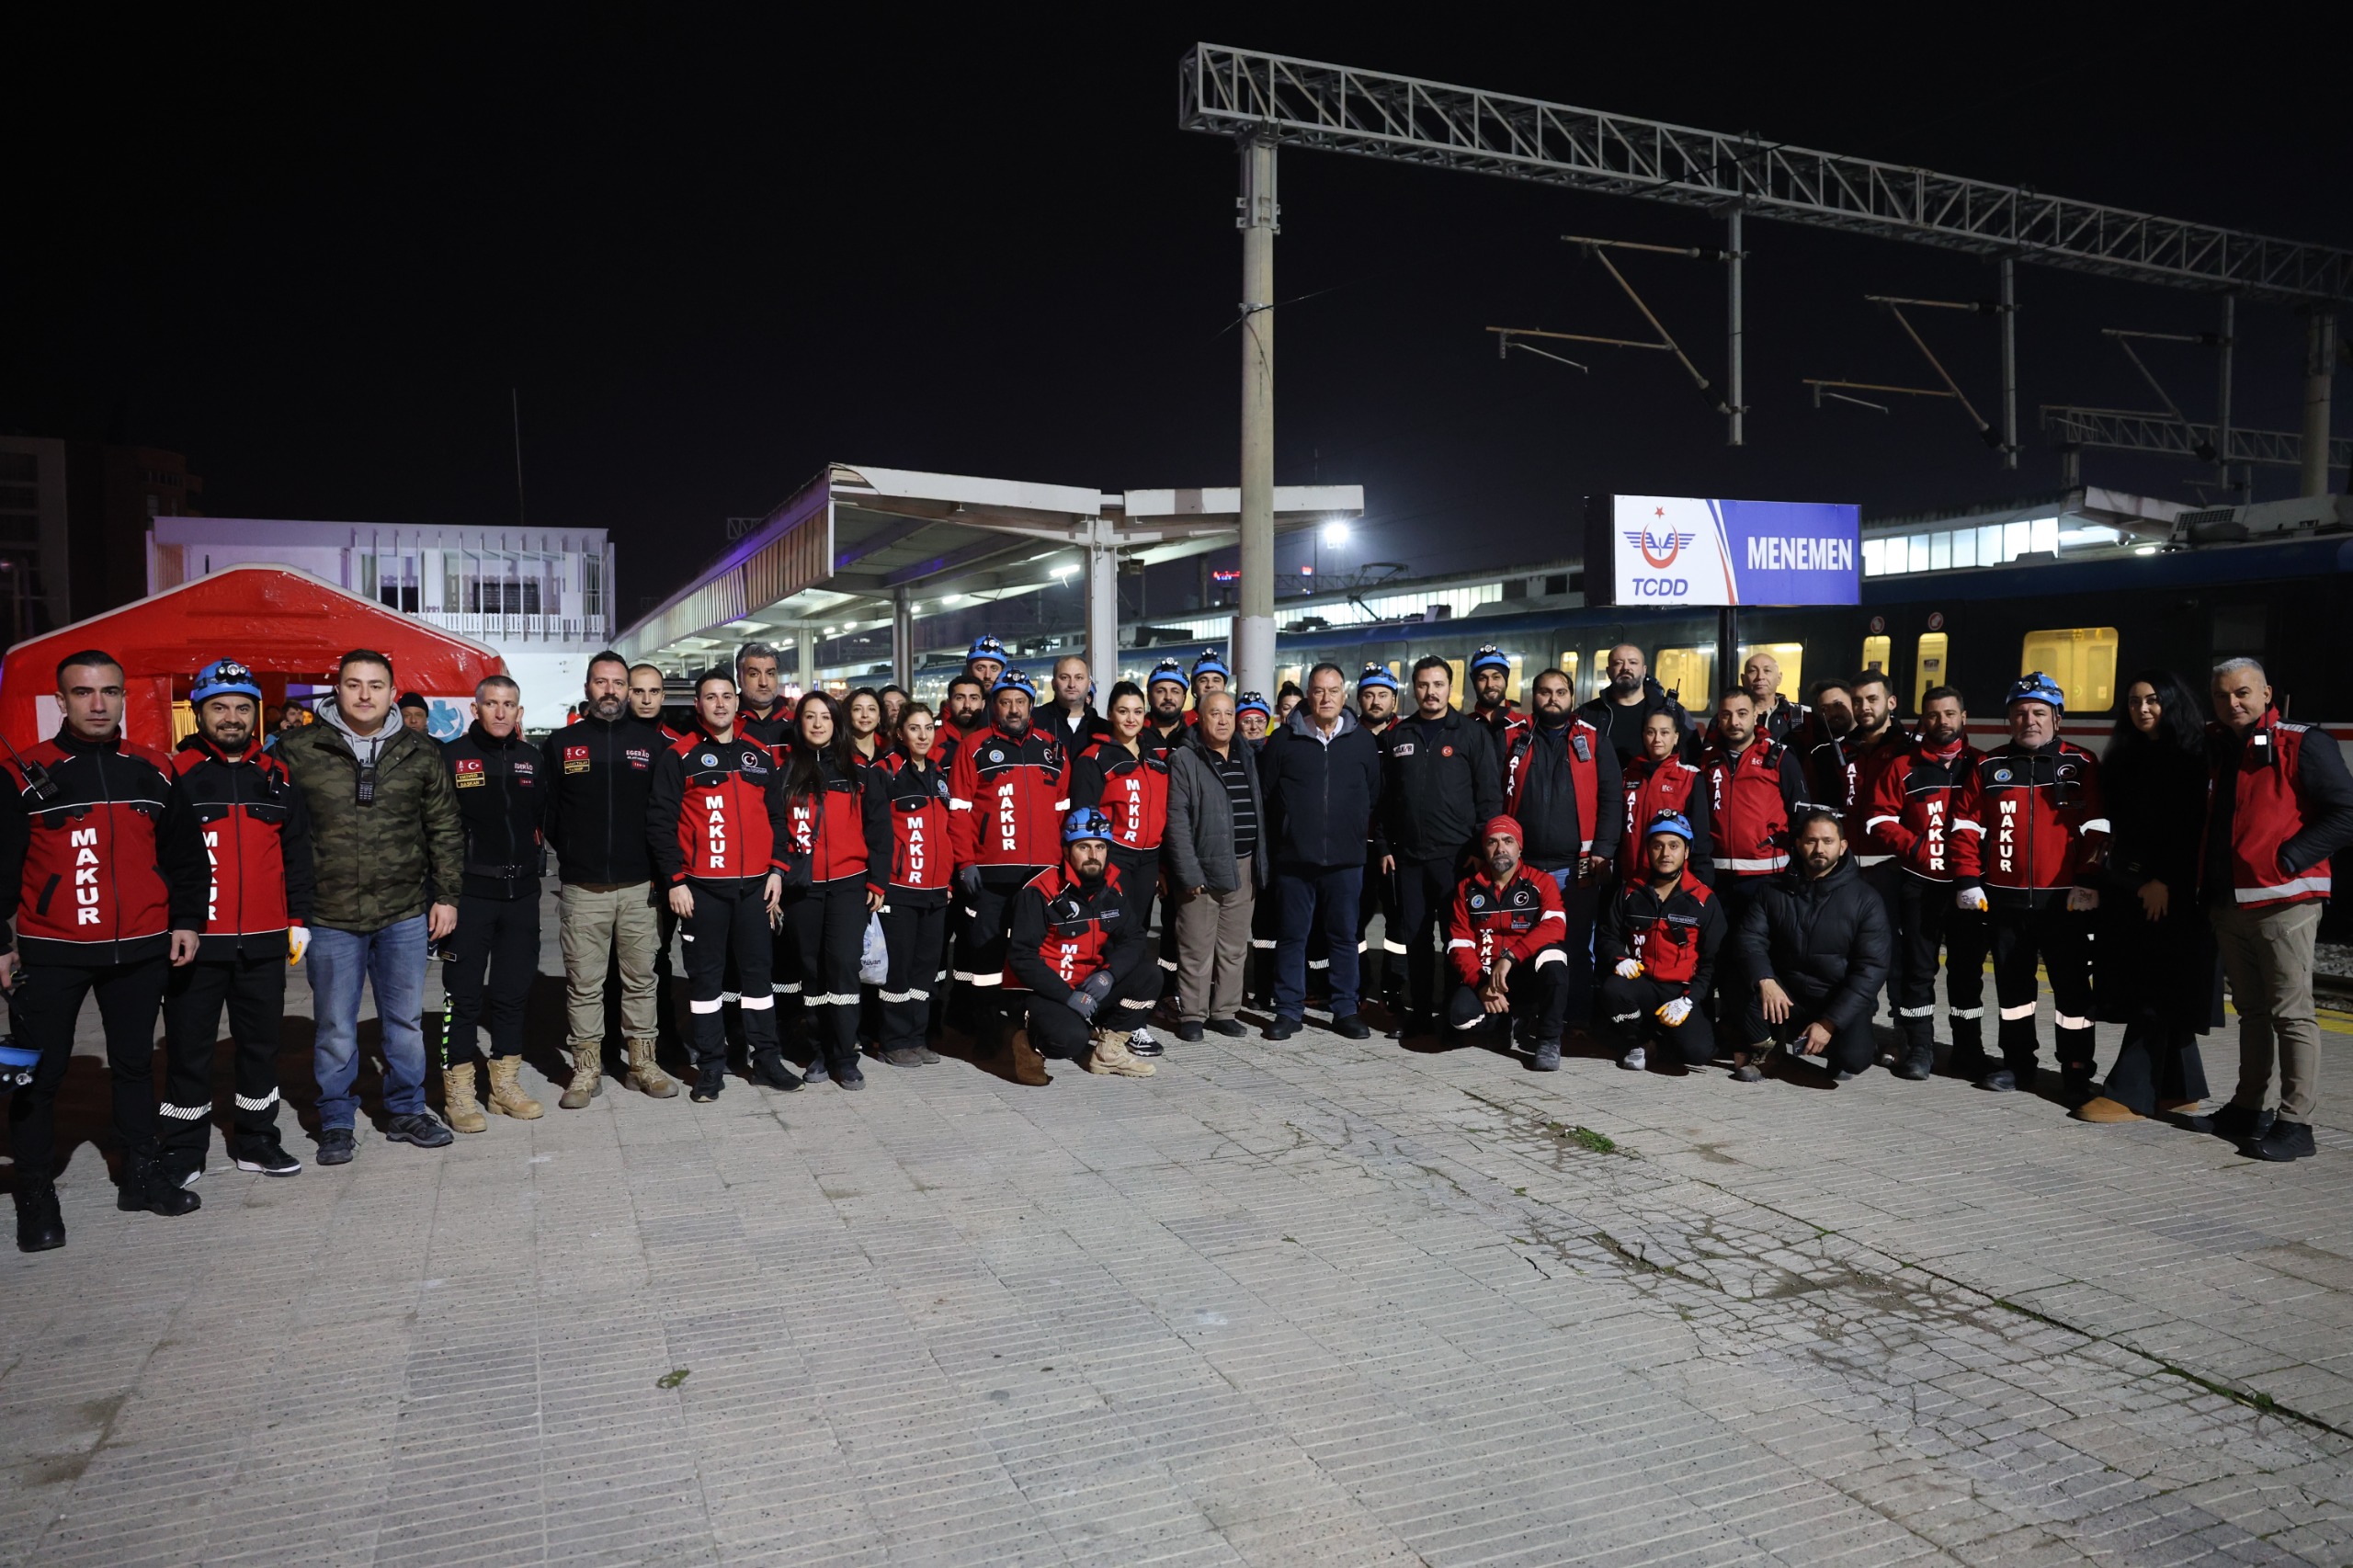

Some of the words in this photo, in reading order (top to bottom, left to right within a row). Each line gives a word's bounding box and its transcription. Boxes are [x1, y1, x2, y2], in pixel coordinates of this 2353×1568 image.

[1747, 537, 1852, 571] MENEMEN
[1632, 578, 1688, 596] TCDD
[1506, 756, 1519, 797] ATAK
[1712, 768, 1723, 811] ATAK
[1847, 763, 1857, 806] ATAK
[706, 795, 725, 869] MAKUR
[793, 806, 812, 855] MAK
[998, 783, 1017, 851] MAKUR
[1125, 778, 1141, 843] MAKUR
[1626, 791, 1637, 834] ATAK
[1927, 800, 1946, 870] MAKUR
[1999, 800, 2017, 873] MAKUR
[71, 827, 101, 926] MAKUR
[907, 816, 925, 884] MAKUR
